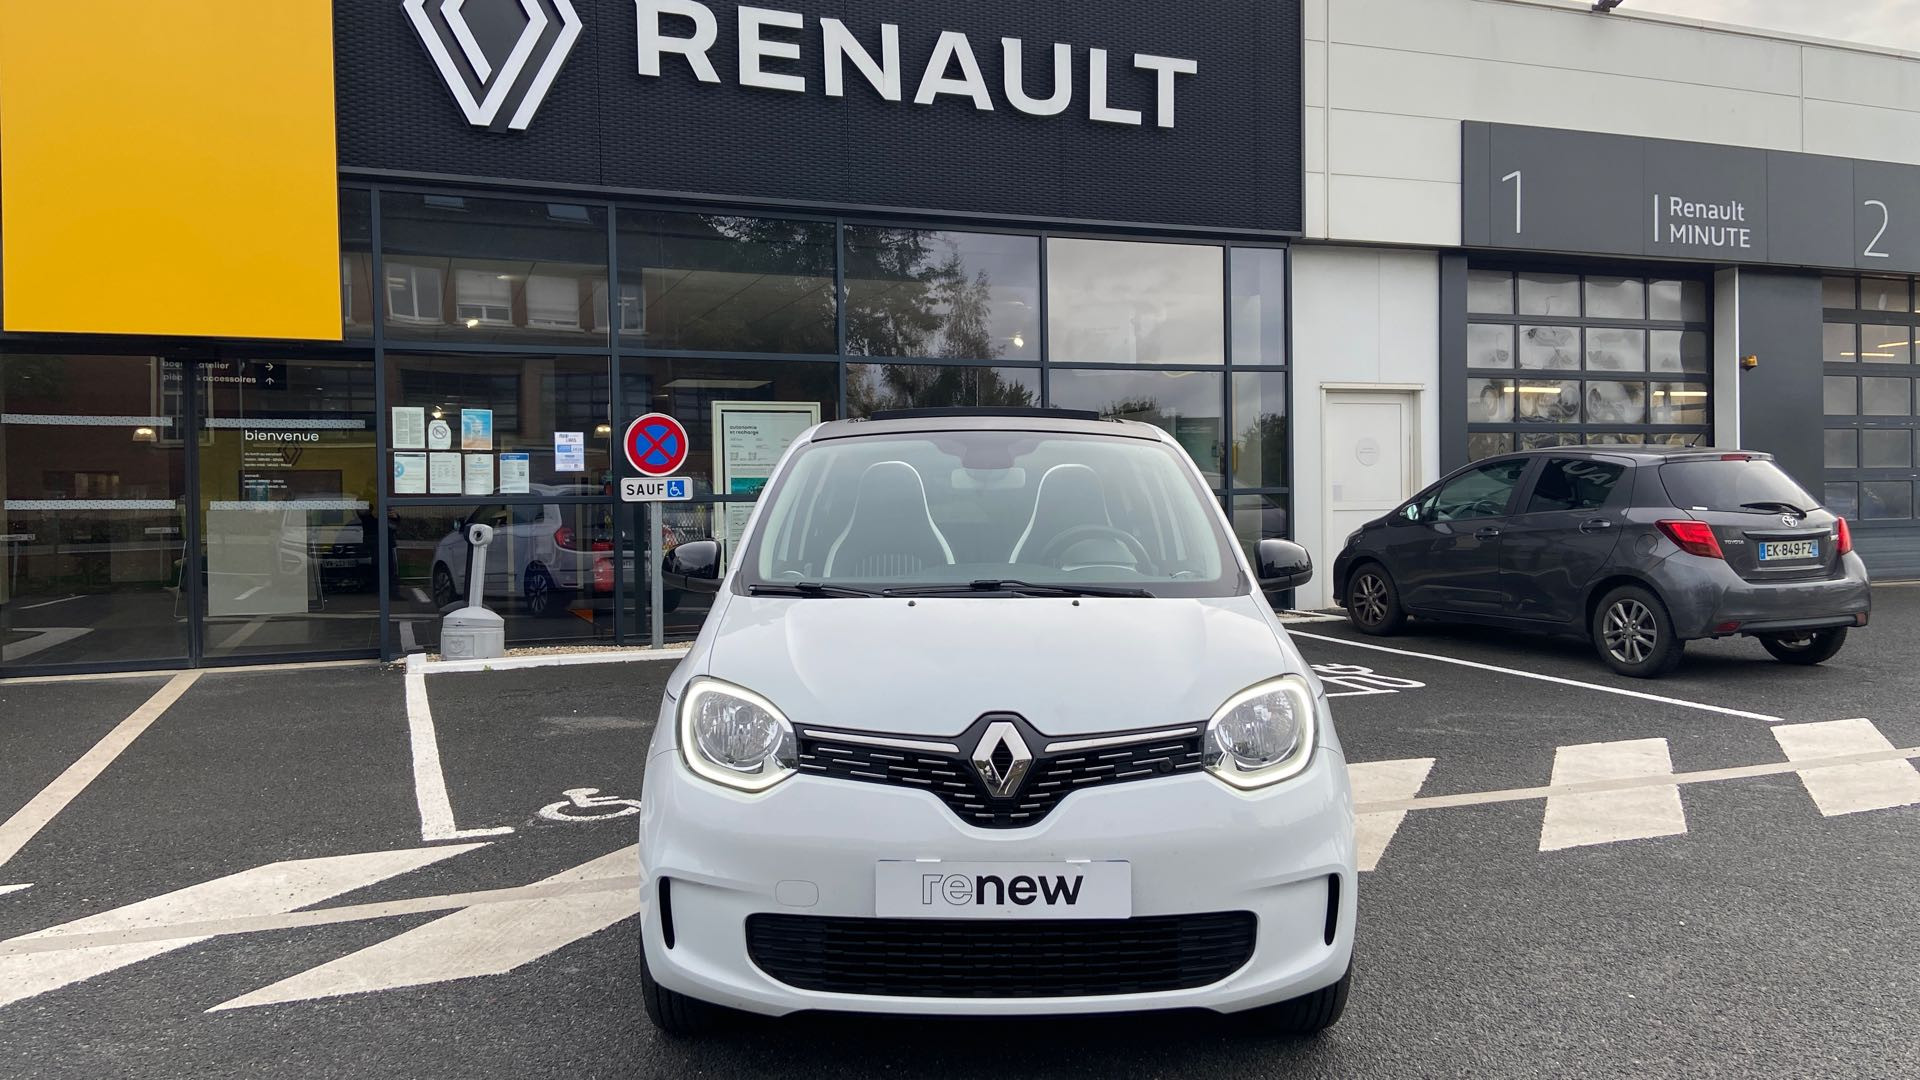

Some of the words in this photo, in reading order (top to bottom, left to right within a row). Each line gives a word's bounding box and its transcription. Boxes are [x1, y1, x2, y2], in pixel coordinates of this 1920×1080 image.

[634, 0, 1198, 128] RENAULT
[1501, 170, 1522, 233] 1
[1670, 196, 1745, 222] Renault
[1670, 223, 1751, 248] MINUTE
[1863, 199, 1890, 258] 2
[203, 375, 257, 383] accessoires
[245, 430, 320, 441] bienvenue
[626, 483, 665, 496] SAUF
[1766, 541, 1813, 557] EK-849-FZ
[922, 873, 1084, 906] renew
